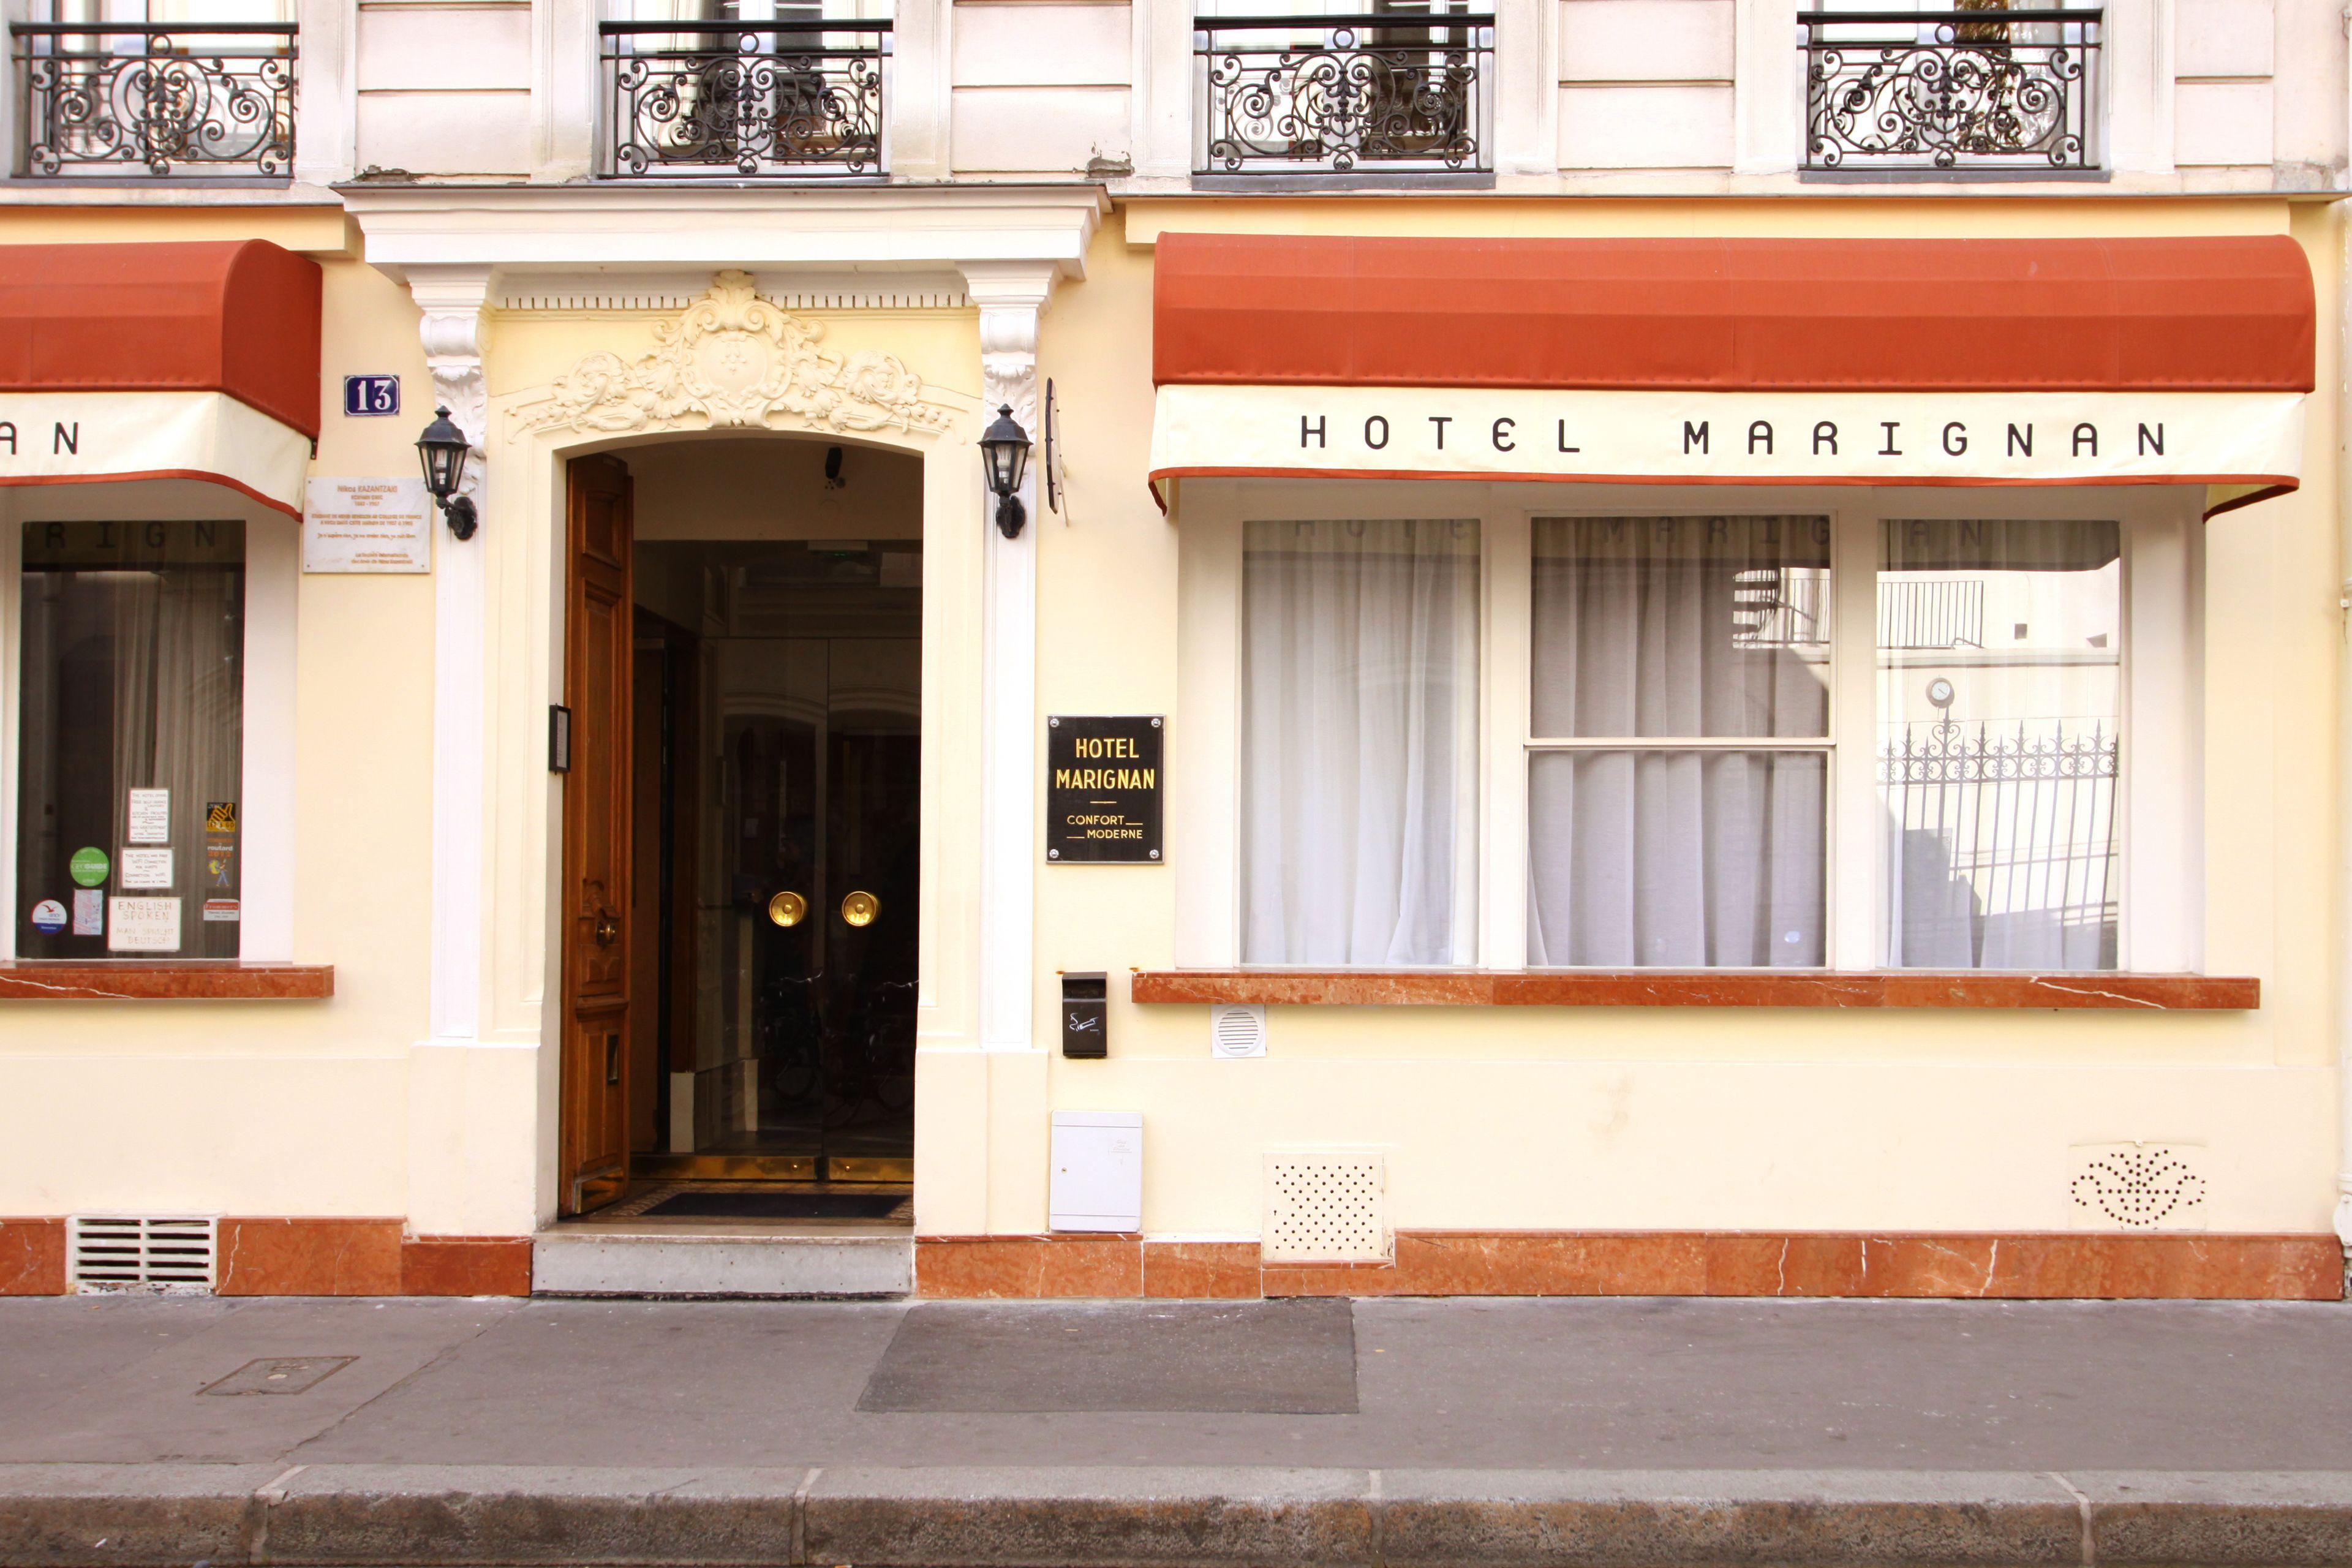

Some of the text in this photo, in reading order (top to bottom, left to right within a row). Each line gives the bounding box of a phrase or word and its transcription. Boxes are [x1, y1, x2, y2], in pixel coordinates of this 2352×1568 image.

[358, 380, 391, 410] 13
[1301, 415, 2164, 457] HOTEL MARIGNAN
[1076, 738, 1139, 758] HOTEL
[1056, 769, 1155, 790] MARIGNAN
[1067, 815, 1125, 825] CONFORT
[1087, 829, 1143, 839] MODERNE
[118, 902, 172, 910] ENGLISH
[123, 911, 169, 920] SPOKEN
